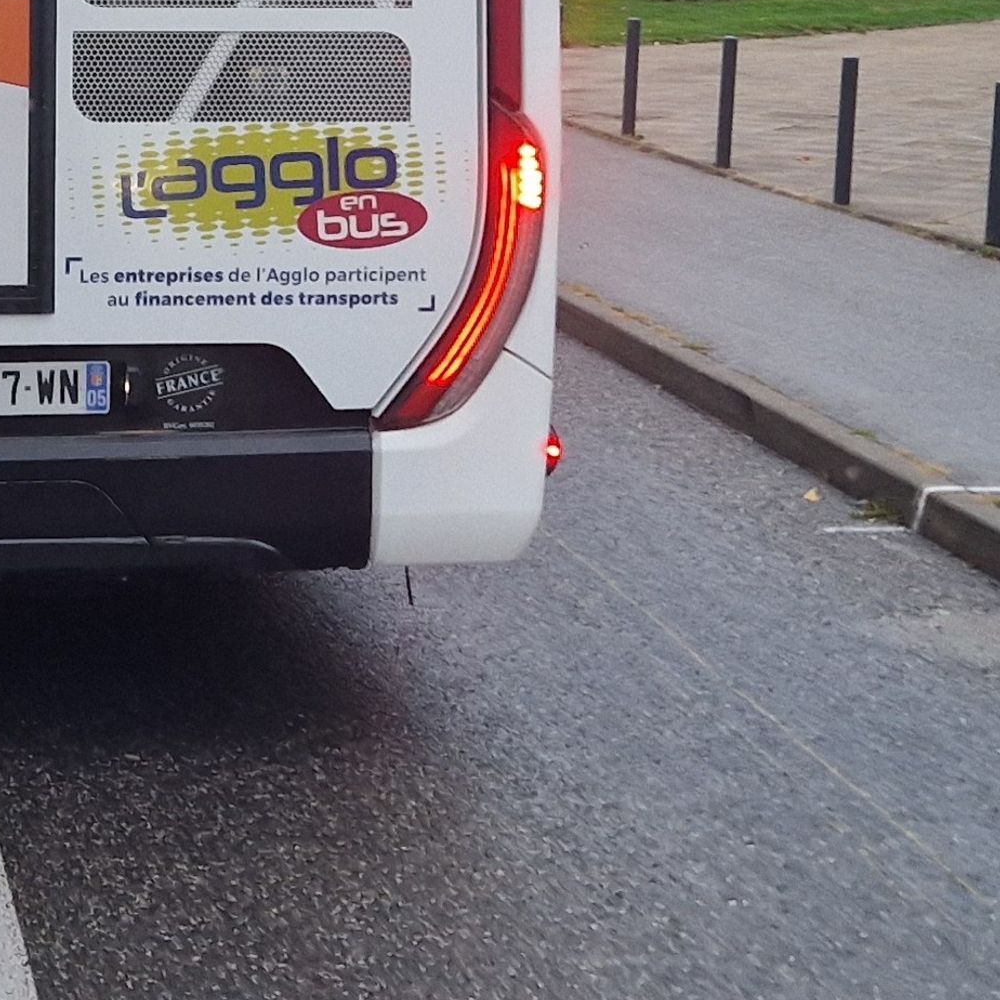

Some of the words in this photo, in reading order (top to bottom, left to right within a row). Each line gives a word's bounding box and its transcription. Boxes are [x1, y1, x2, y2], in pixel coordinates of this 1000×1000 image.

[340, 195, 377, 210] en
[316, 210, 408, 241] bus
[80, 269, 109, 283] Les
[114, 266, 223, 286] entreprises
[228, 268, 251, 282] de
[256, 267, 319, 285] l'Agglo
[325, 266, 427, 285] participent
[107, 295, 129, 306] au
[135, 291, 256, 306] financement
[261, 291, 294, 305] des
[299, 292, 398, 309] transports
[155, 368, 220, 395] FRANCE
[87, 389, 106, 407] 05
